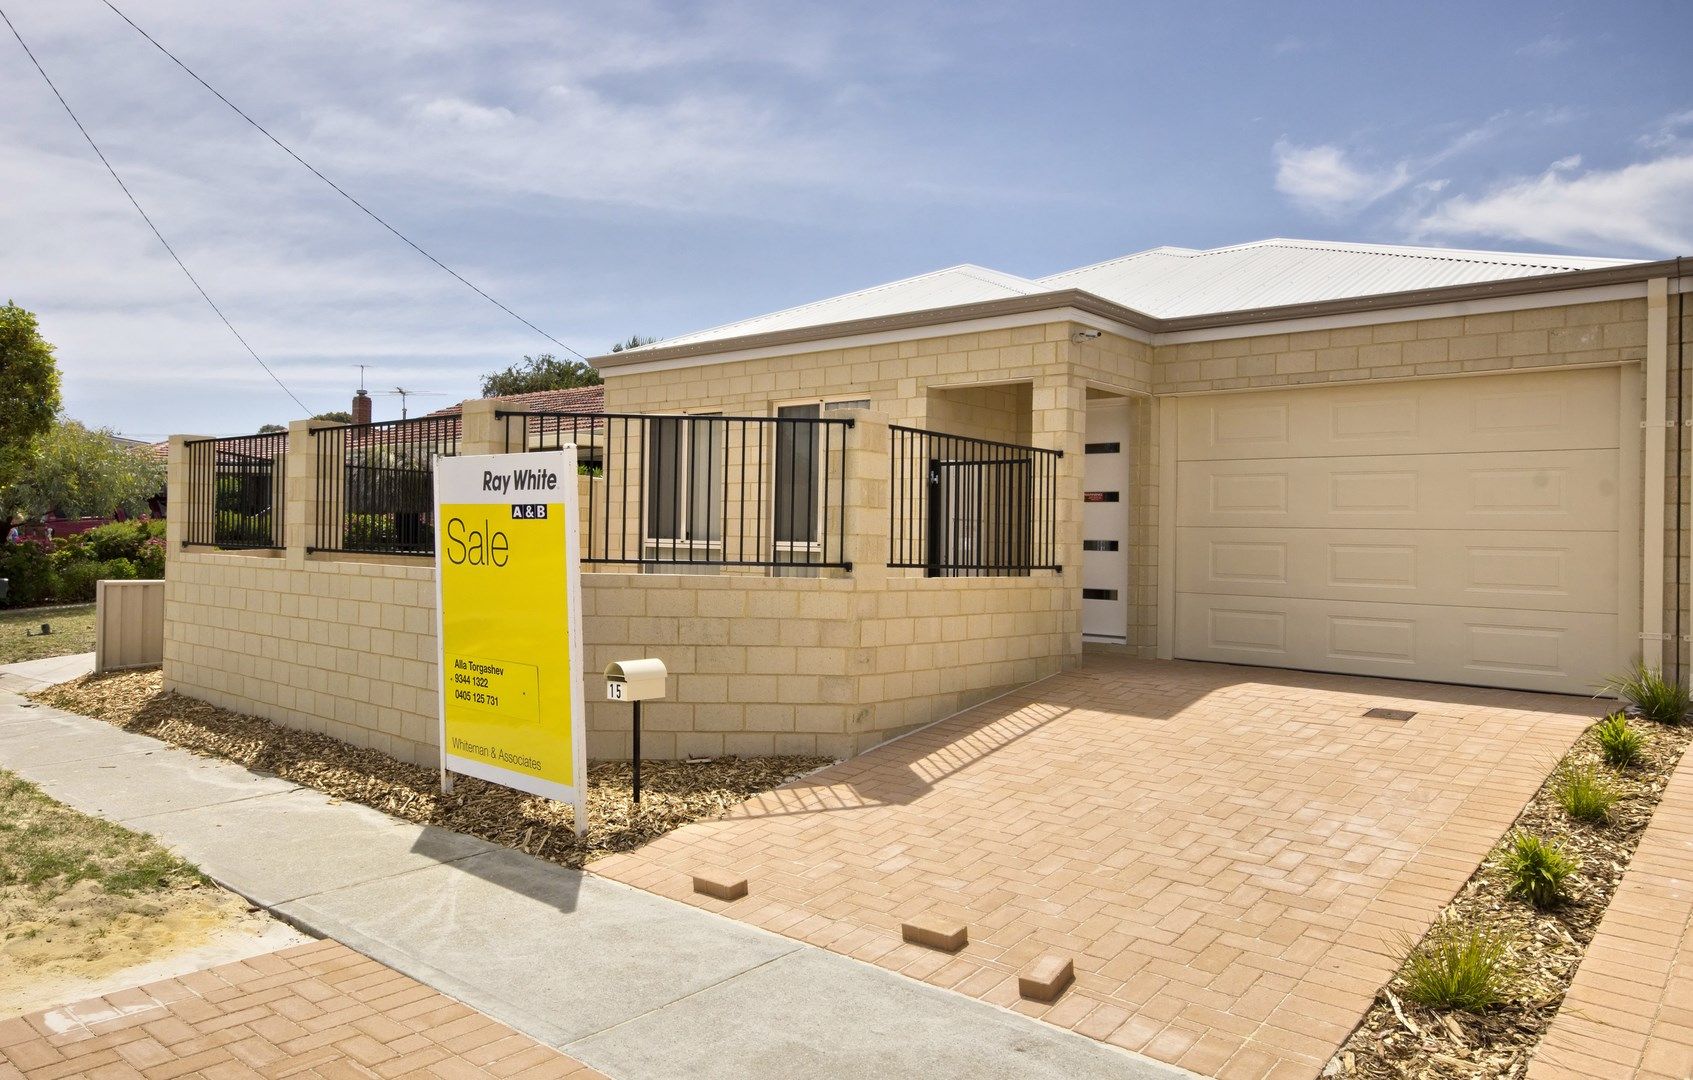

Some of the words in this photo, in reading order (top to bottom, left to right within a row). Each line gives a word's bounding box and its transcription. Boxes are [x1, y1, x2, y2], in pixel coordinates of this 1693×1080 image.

[482, 470, 510, 495] Ray
[514, 468, 556, 490] White
[447, 517, 508, 568] Sale
[454, 658, 467, 670] Alla
[468, 660, 504, 676] Torgashev
[454, 674, 470, 684] 9344
[473, 677, 488, 688] 1322
[455, 690, 470, 701] 0405
[474, 694, 485, 704] 125
[487, 695, 498, 706] 731
[610, 684, 622, 698] 15
[452, 736, 488, 756] Whiteman
[490, 746, 496, 758] &
[498, 748, 542, 770] Associates
